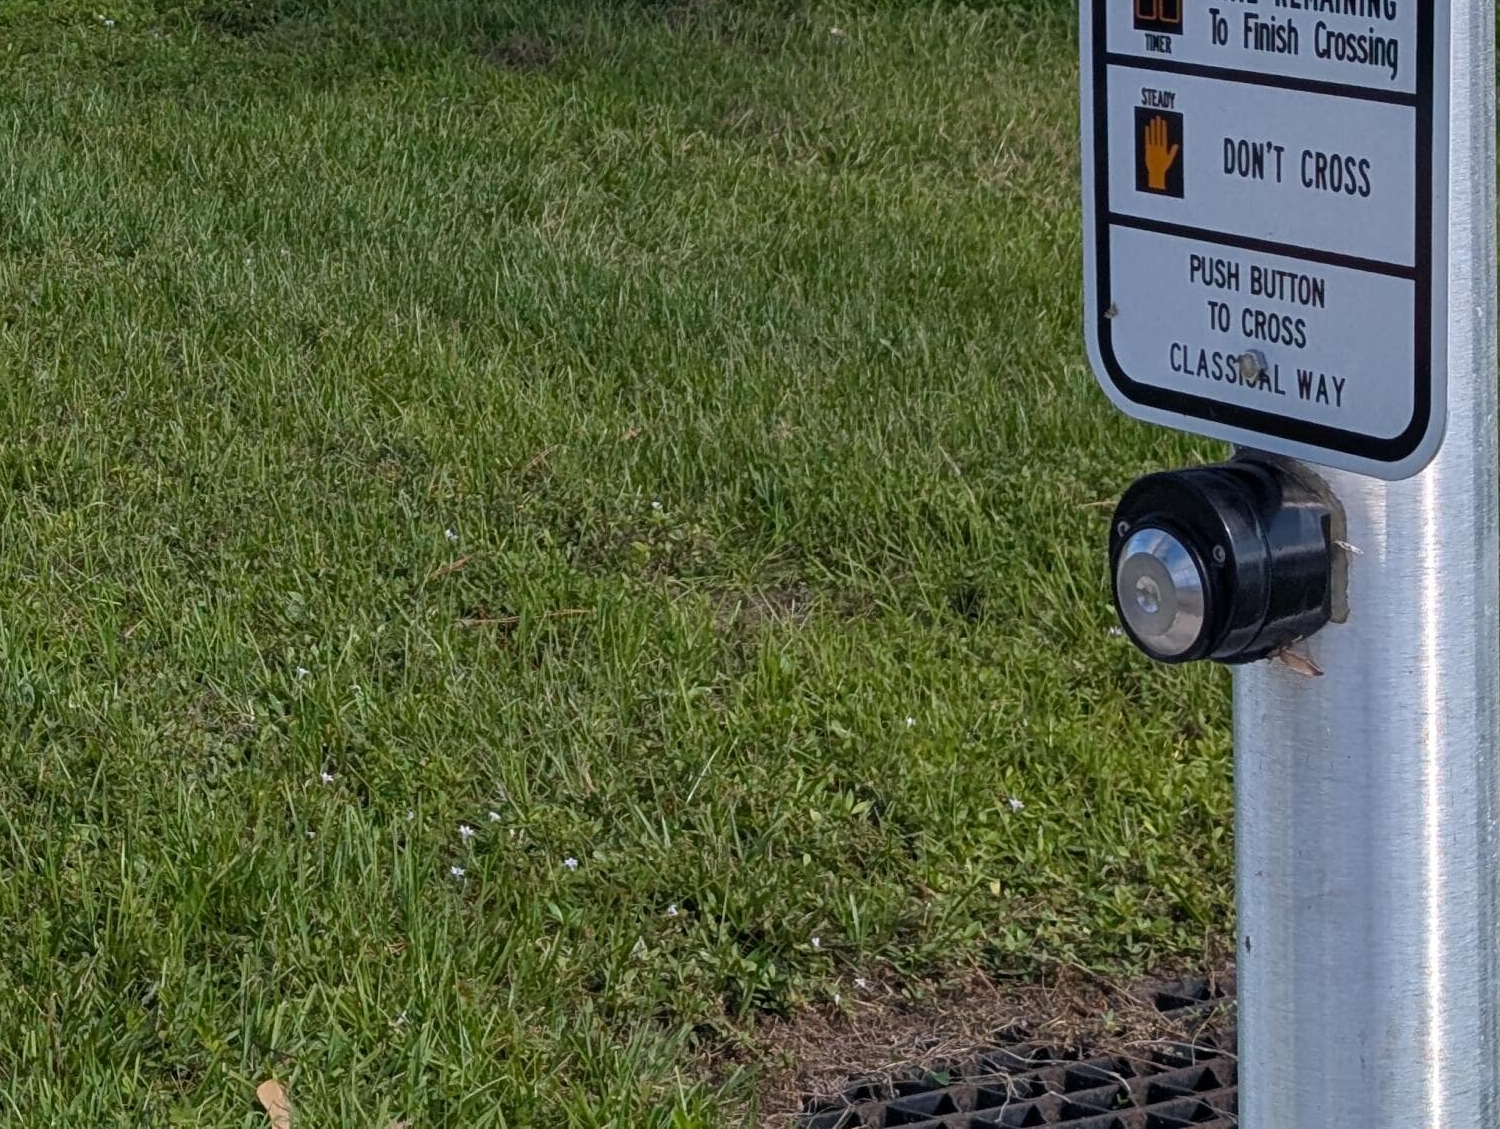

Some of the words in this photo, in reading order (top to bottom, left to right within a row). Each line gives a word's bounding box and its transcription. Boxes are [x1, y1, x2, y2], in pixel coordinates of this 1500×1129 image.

[1145, 33, 1172, 54] TIMER
[1209, 8, 1228, 46] To
[1244, 12, 1299, 55] Finish
[1314, 21, 1398, 80] Crossing
[1141, 88, 1176, 109] STEADY
[1223, 138, 1284, 183] DON'T
[1301, 150, 1370, 197] CROSS
[1190, 254, 1239, 291] PUSH
[1251, 266, 1325, 308] BUTTON
[1208, 301, 1230, 332] TO
[1242, 308, 1306, 348] CROSS
[1298, 369, 1345, 408] WAY
